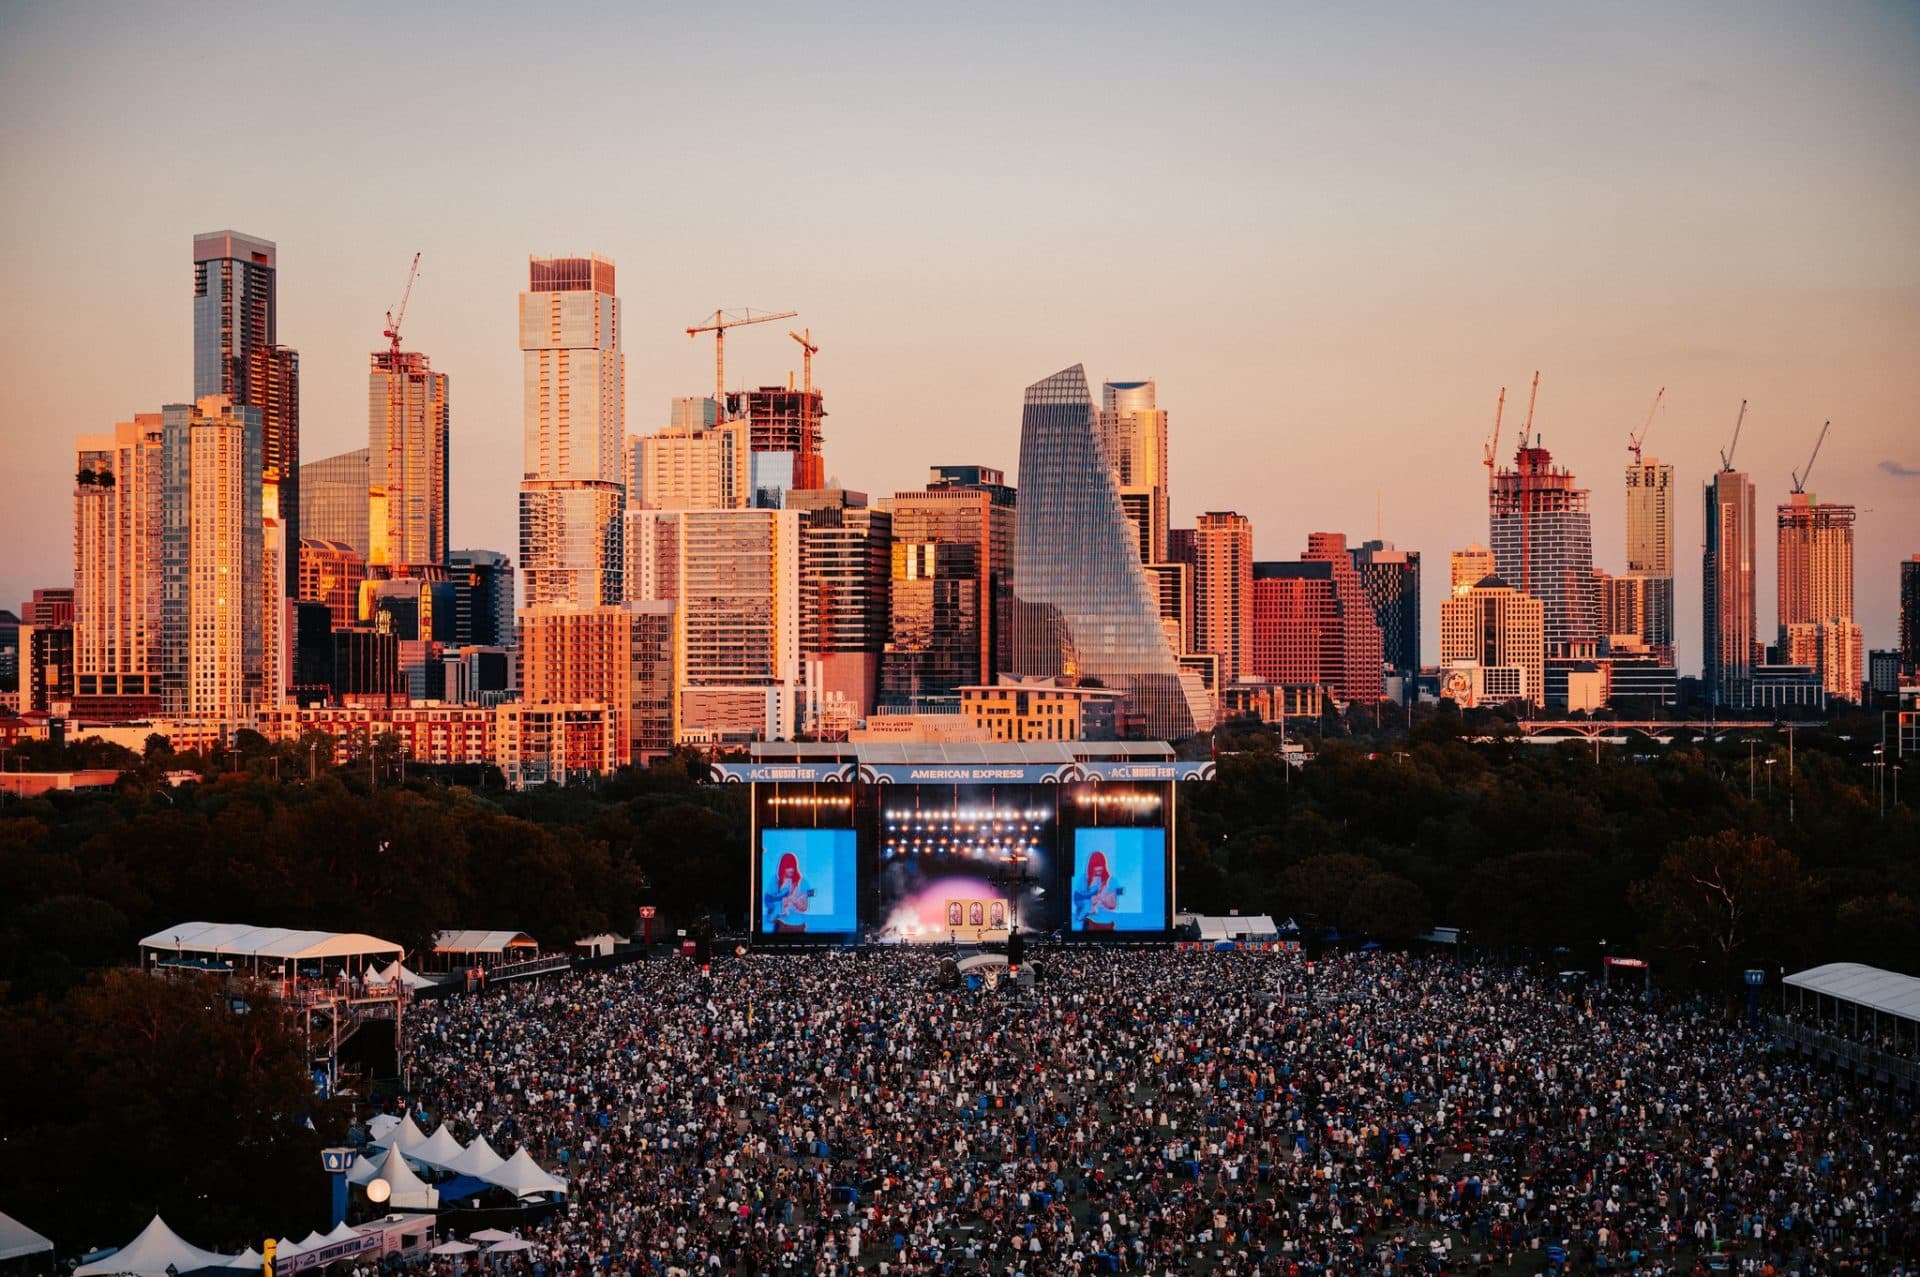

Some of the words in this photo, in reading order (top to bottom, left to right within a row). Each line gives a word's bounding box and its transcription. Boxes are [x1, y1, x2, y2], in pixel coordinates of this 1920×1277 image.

[750, 768, 771, 779] ACL
[771, 768, 796, 779] MUSIC
[797, 769, 816, 779] FEST
[911, 769, 969, 779] AMERICAN
[972, 769, 1025, 779] EXPRESS
[1111, 767, 1132, 778] ACL
[1132, 767, 1156, 778] MUSIC
[1158, 767, 1176, 778] FEST
